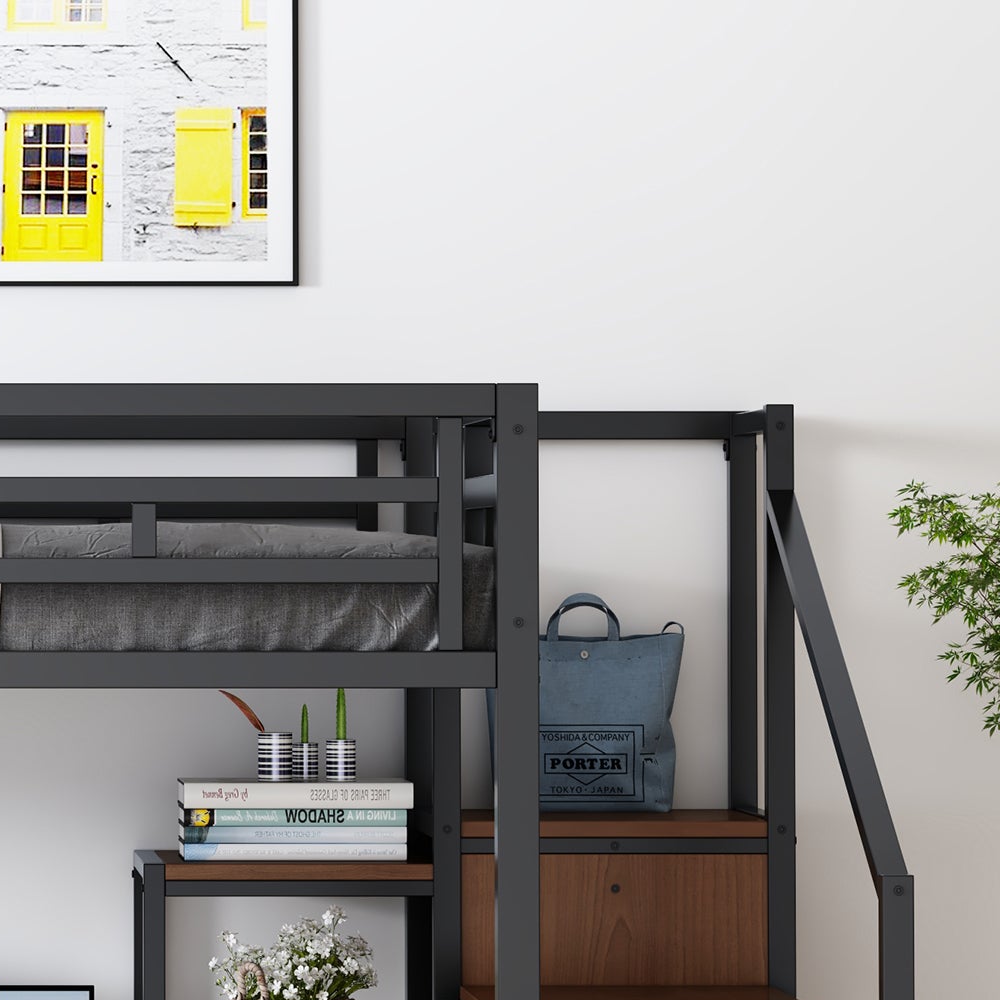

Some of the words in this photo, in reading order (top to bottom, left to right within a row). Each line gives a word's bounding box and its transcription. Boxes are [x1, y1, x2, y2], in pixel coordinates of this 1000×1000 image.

[549, 758, 622, 770] PORTER
[551, 786, 583, 794] TOKYO
[591, 786, 624, 794] JAPAN
